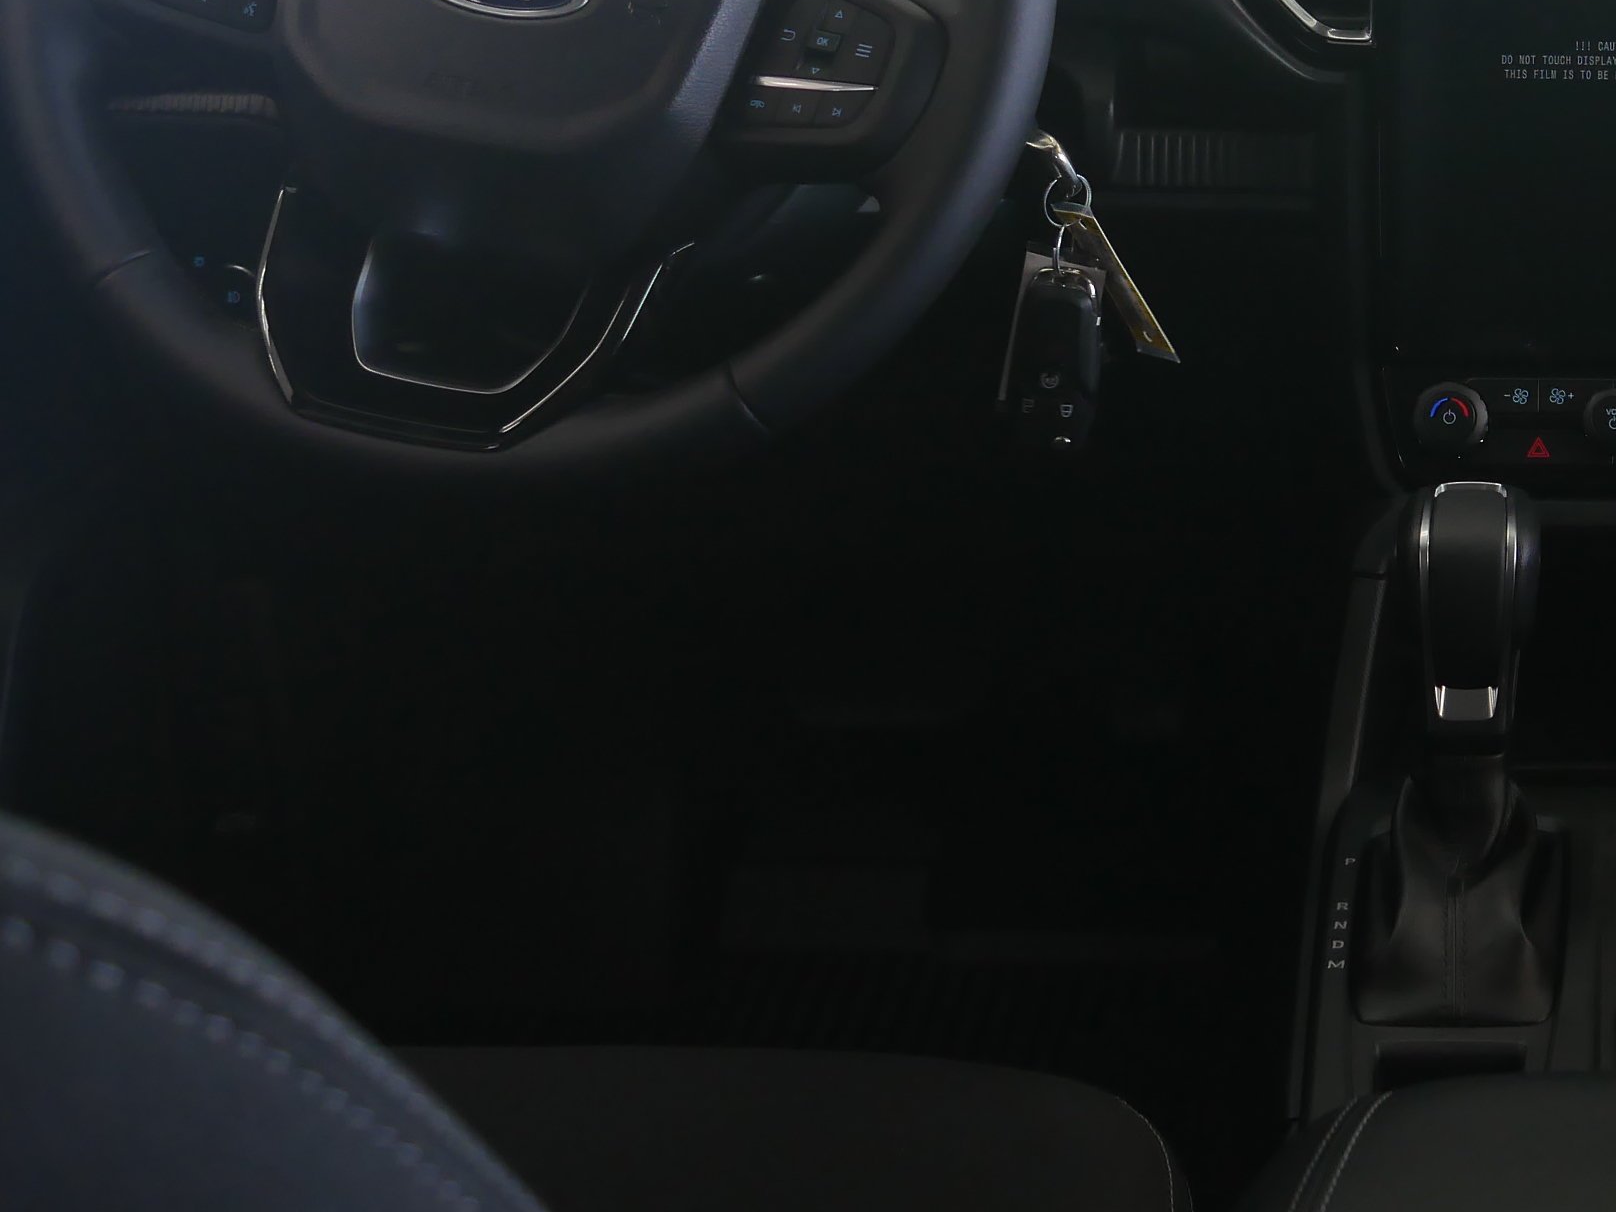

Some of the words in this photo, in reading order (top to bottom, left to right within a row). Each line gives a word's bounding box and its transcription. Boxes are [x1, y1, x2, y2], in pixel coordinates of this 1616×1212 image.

[816, 36, 831, 48] OK
[1501, 55, 1514, 65] DO
[1519, 55, 1537, 65] NOT
[1542, 55, 1572, 66] TOUCH
[1504, 69, 1528, 80] THIS
[1533, 69, 1557, 80] FILM
[1563, 70, 1574, 80] IS
[1580, 70, 1592, 80] TO
[1597, 70, 1609, 80] BE
[1344, 857, 1356, 866] P
[1336, 901, 1349, 911] R
[1333, 920, 1348, 930] N
[1332, 939, 1345, 949] D
[1327, 959, 1345, 969] M
